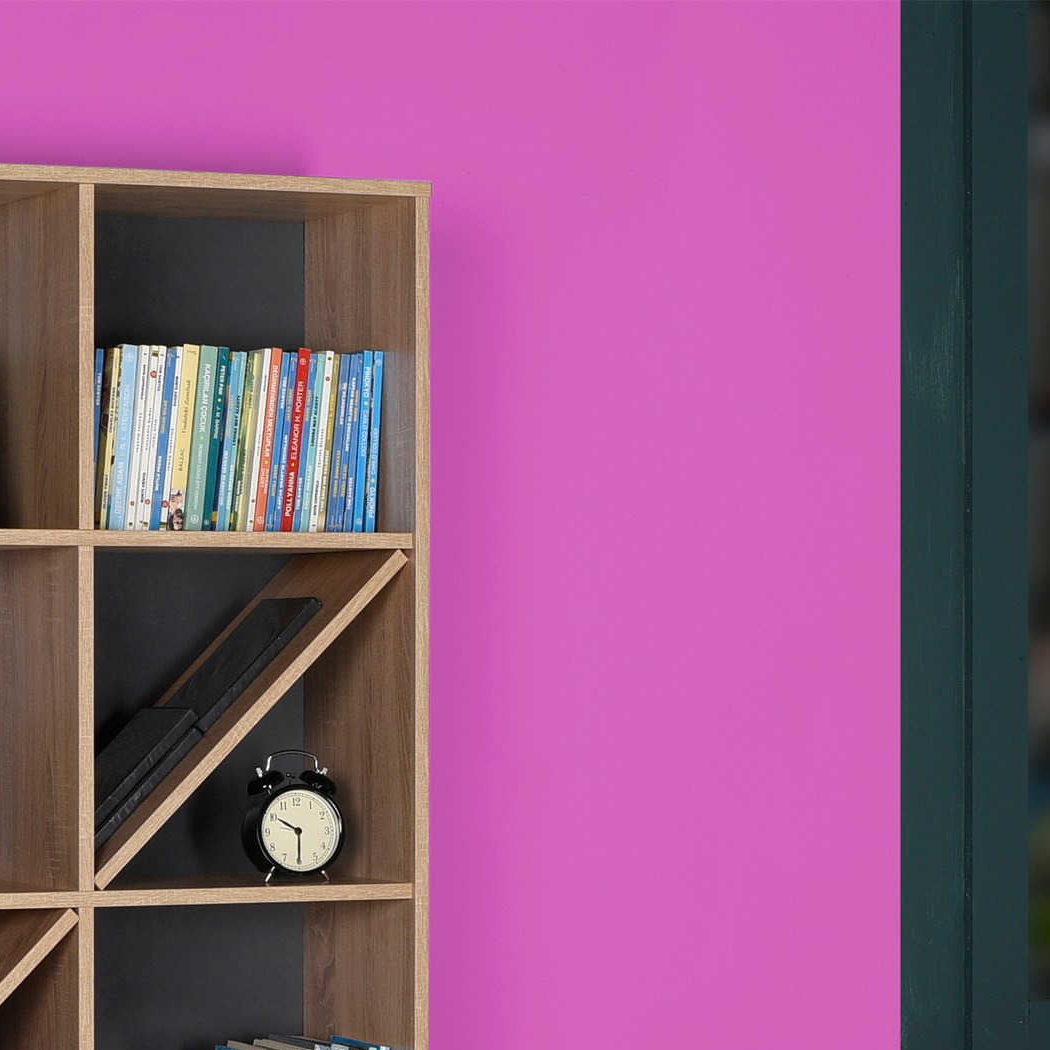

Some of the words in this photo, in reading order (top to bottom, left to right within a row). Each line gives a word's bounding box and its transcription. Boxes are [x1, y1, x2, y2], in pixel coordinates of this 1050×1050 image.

[201, 363, 213, 404] KAÇIRILAN
[295, 380, 304, 412] PORTER
[199, 405, 209, 433] ÇOCUK
[294, 414, 301, 422] H.
[290, 423, 300, 460] ELEANOR
[284, 471, 296, 517] POLLYANNA
[280, 802, 286, 810] 11
[292, 798, 300, 806] 12
[270, 813, 277, 821] 10
[319, 811, 325, 820] 2
[265, 828, 270, 837] 9
[325, 826, 330, 835] 3
[270, 843, 275, 851] 8
[282, 853, 287, 861] 7
[313, 852, 318, 861] 5
